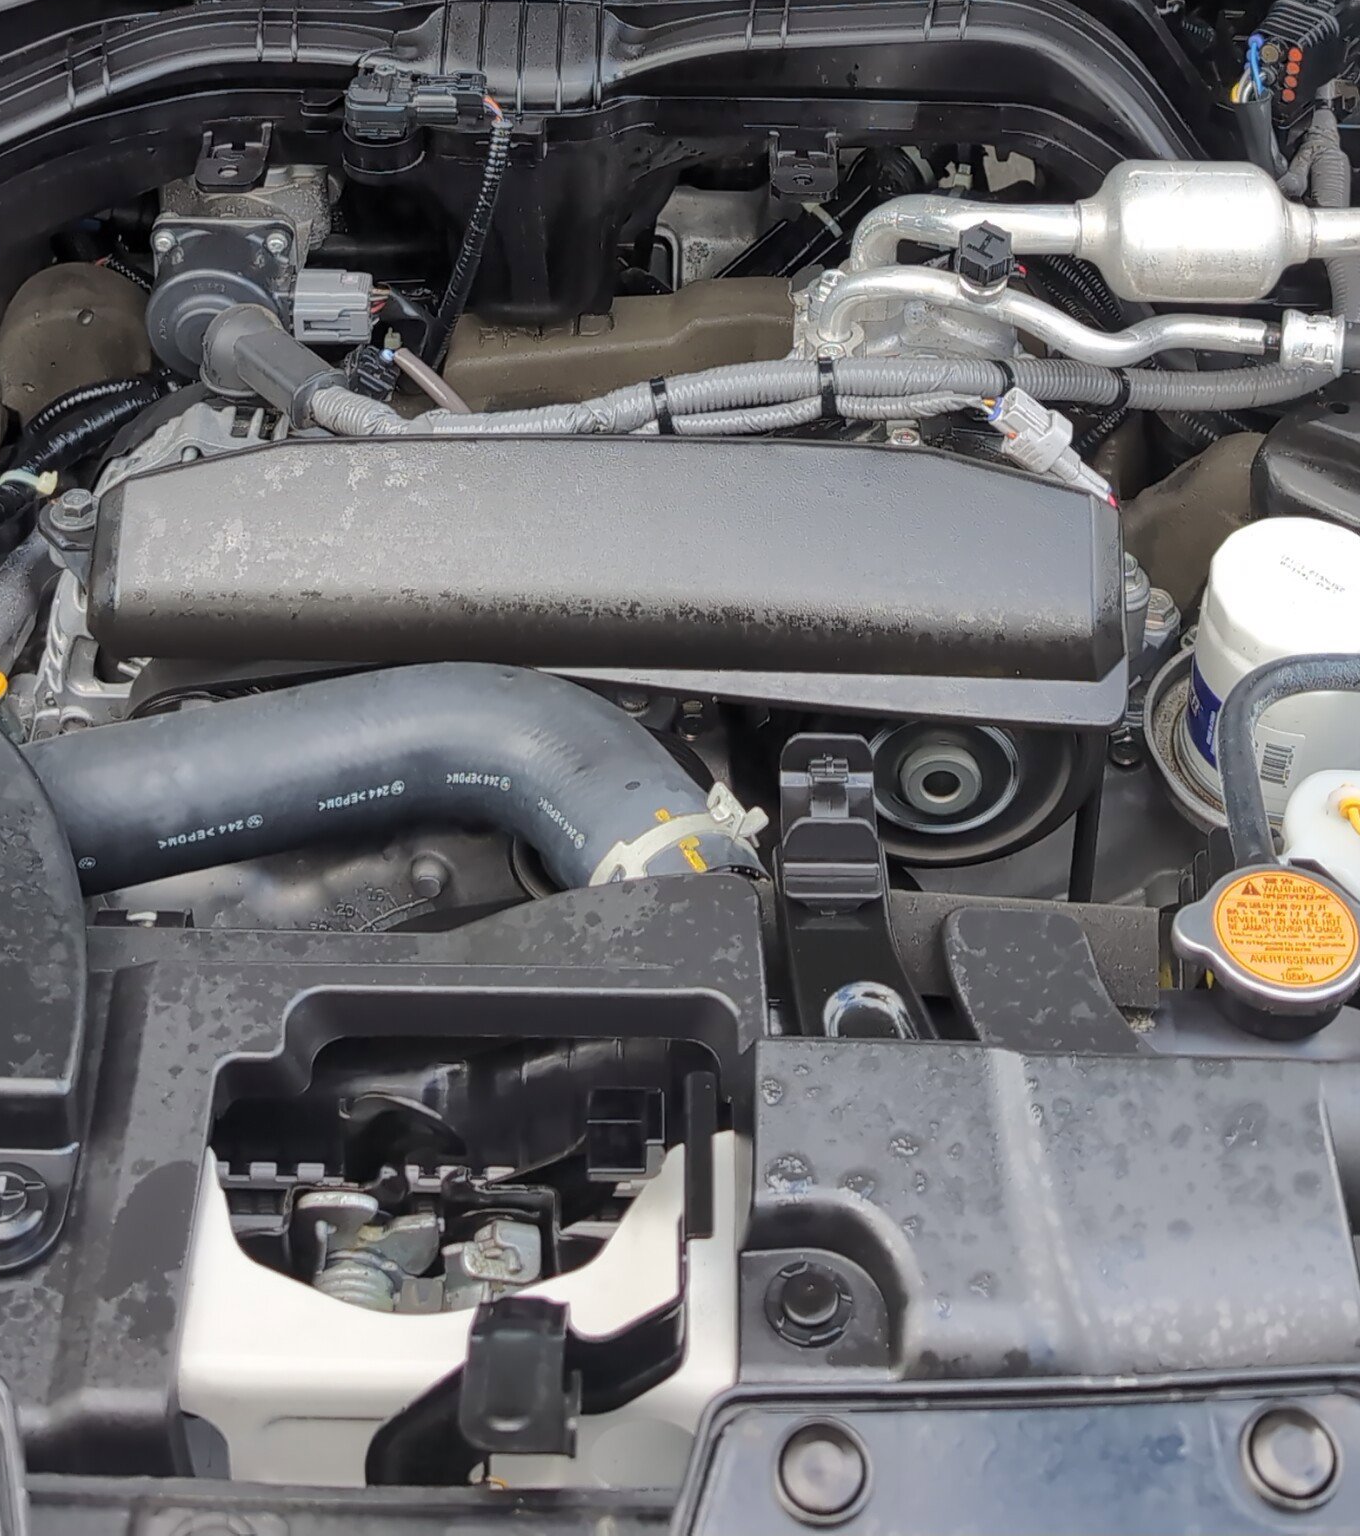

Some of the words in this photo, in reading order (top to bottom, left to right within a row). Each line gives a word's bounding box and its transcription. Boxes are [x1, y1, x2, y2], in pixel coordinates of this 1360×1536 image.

[368, 783, 390, 800] 244
[218, 819, 244, 835] 244
[1262, 885, 1317, 894] WARNING
[1249, 954, 1336, 966] AVERTISSEMENT
